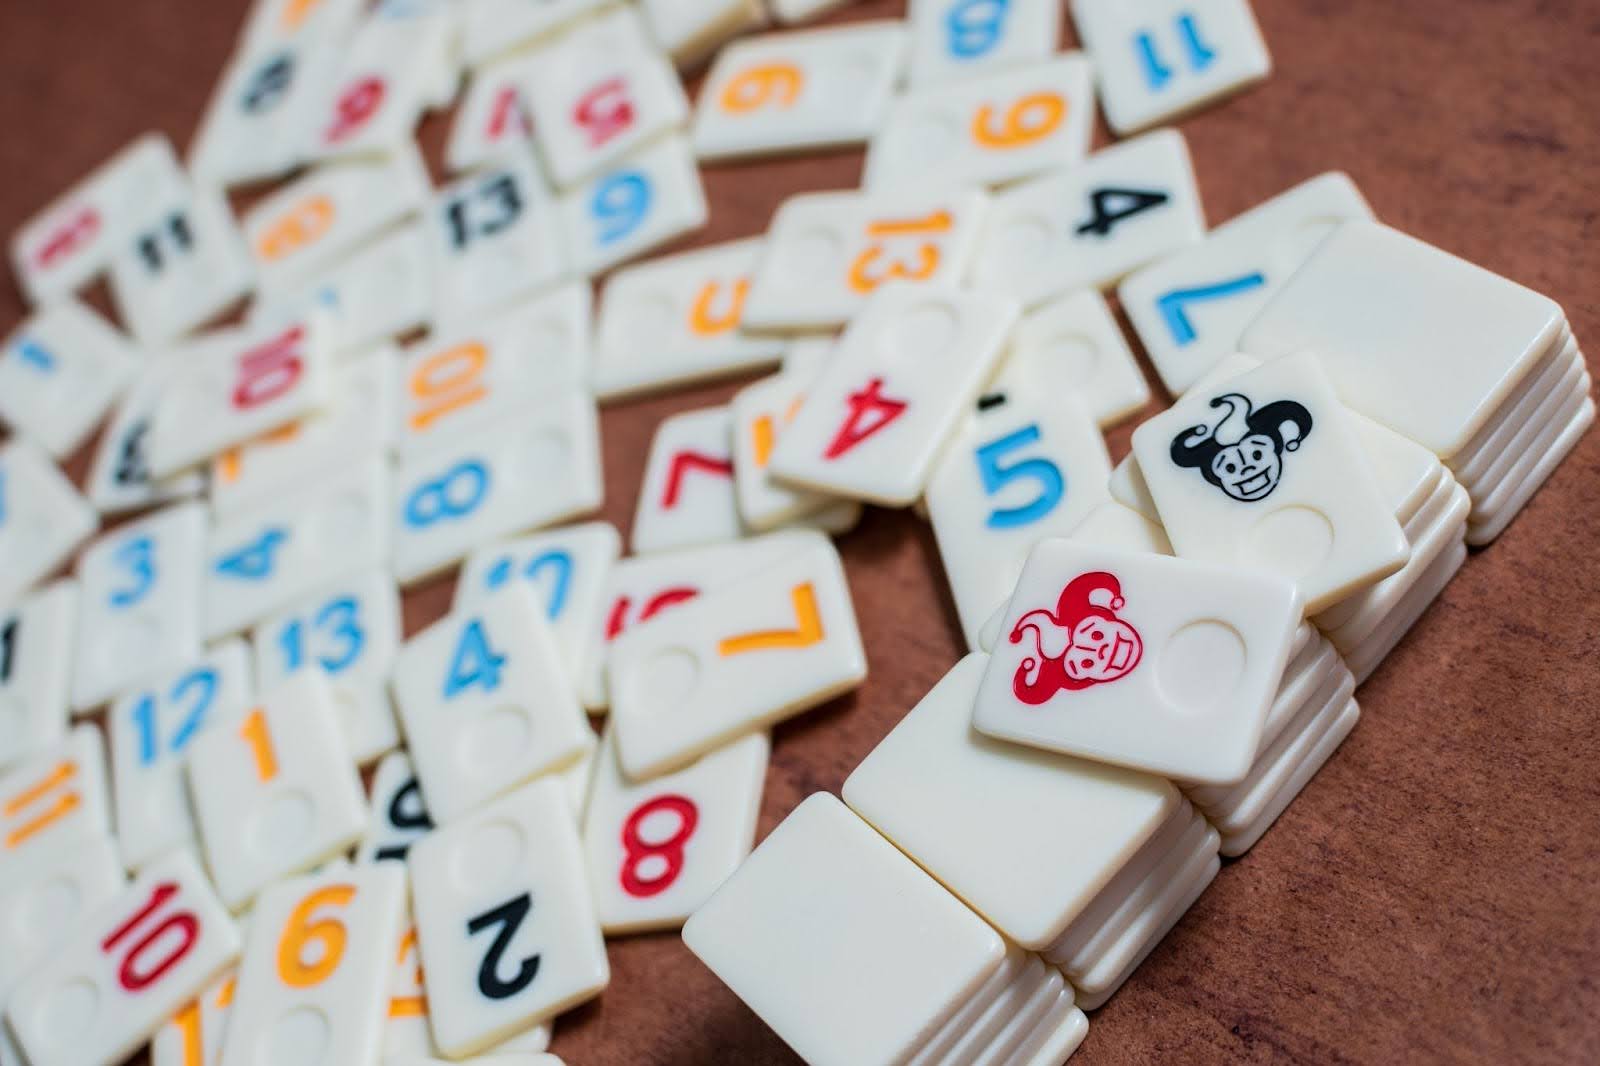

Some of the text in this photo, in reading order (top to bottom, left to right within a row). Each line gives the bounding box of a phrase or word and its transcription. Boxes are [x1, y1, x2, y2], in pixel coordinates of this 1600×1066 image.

[848, 212, 952, 294] 13
[1073, 187, 1170, 239] 4
[1155, 272, 1264, 347] 7
[410, 343, 487, 430] 10
[824, 379, 907, 460] 4
[402, 460, 490, 530] 8
[975, 425, 1065, 529] 5
[278, 597, 366, 675] 13
[443, 619, 507, 698] 4
[719, 583, 824, 656] 7
[242, 711, 277, 781] 1
[619, 794, 699, 900] 8
[101, 883, 200, 993] 10
[277, 886, 354, 988] 6
[468, 893, 540, 1000] 2
